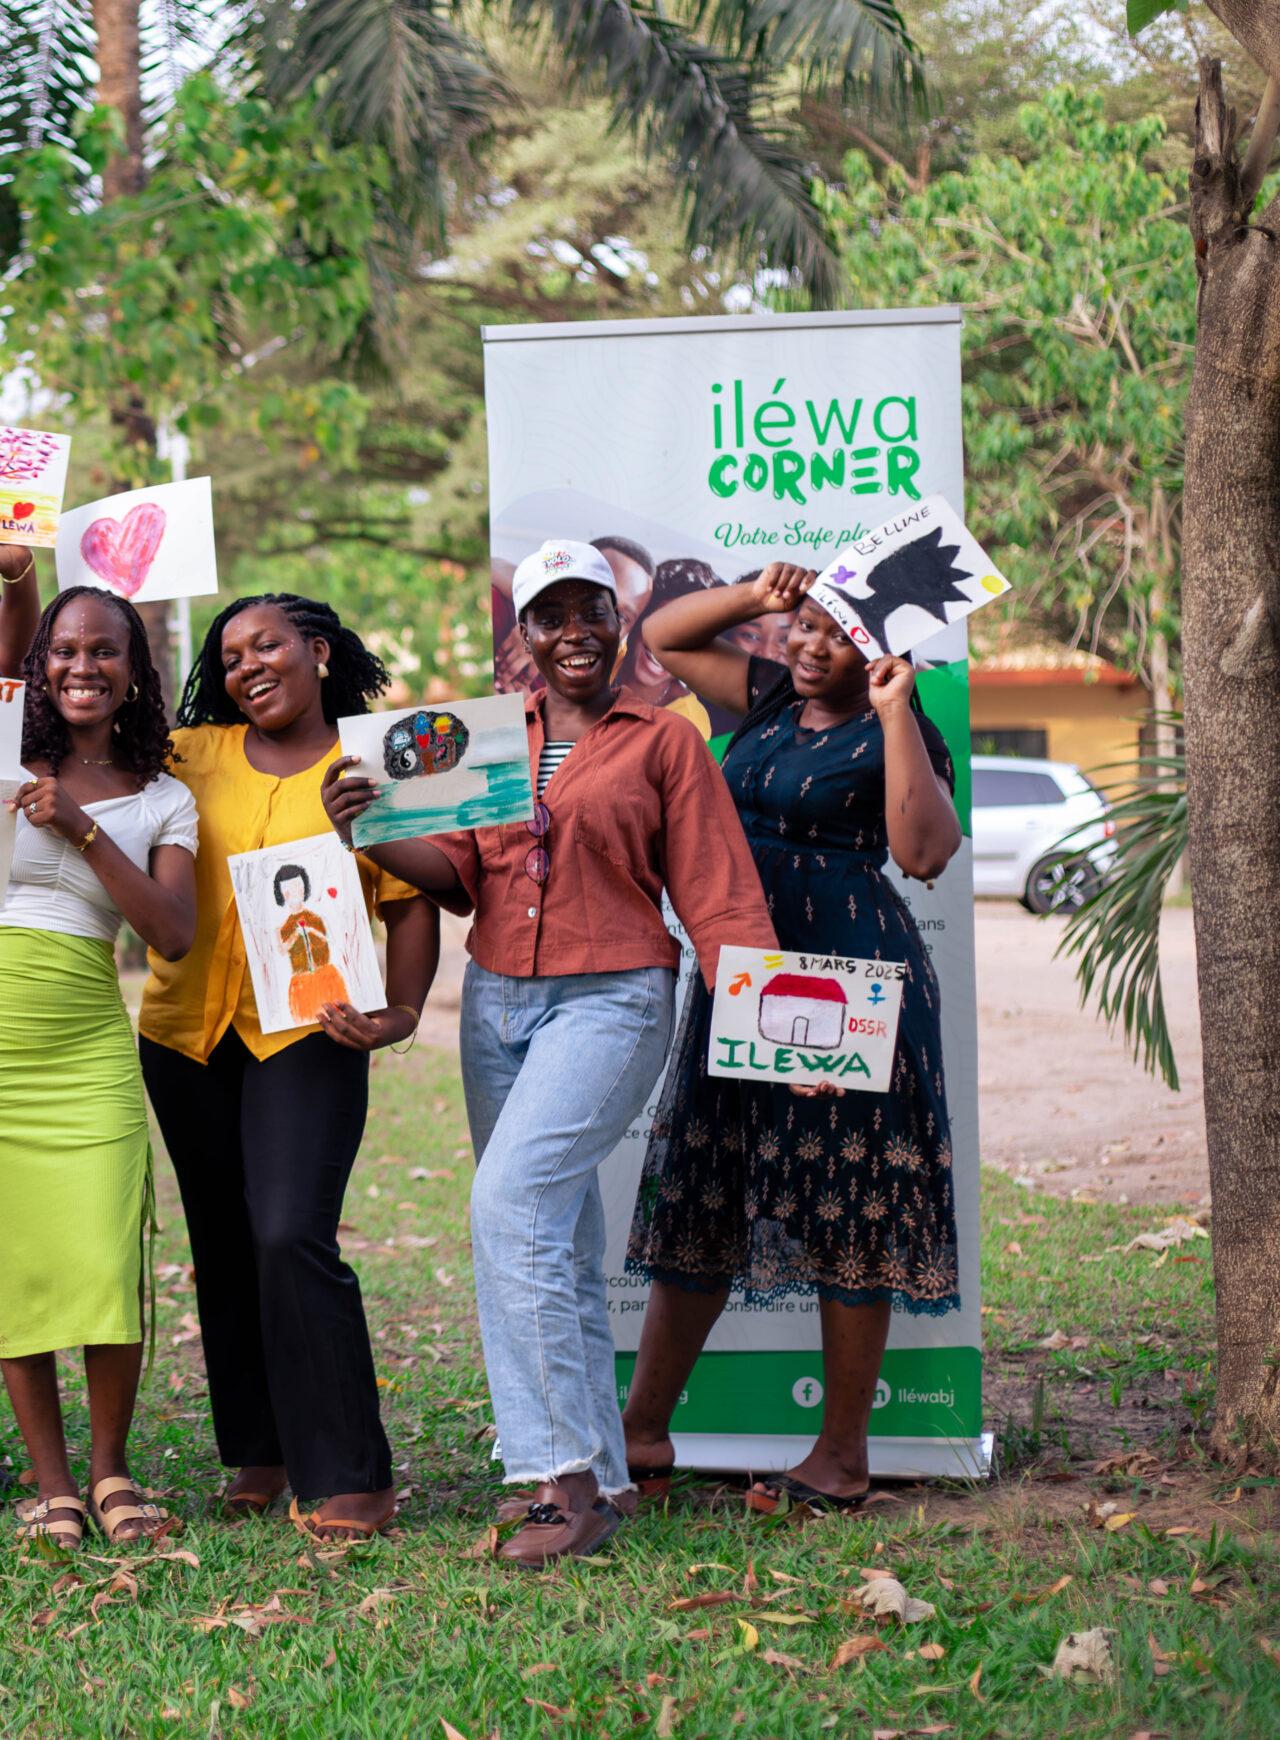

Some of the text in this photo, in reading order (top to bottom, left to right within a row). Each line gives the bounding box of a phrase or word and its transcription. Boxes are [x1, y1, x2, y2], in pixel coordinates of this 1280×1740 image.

[711, 377, 918, 449] iléwa
[708, 445, 922, 506] CORNER
[714, 519, 872, 550] Votre Safe pla
[864, 962, 906, 981] 2025
[716, 1036, 872, 1079] ILEWA
